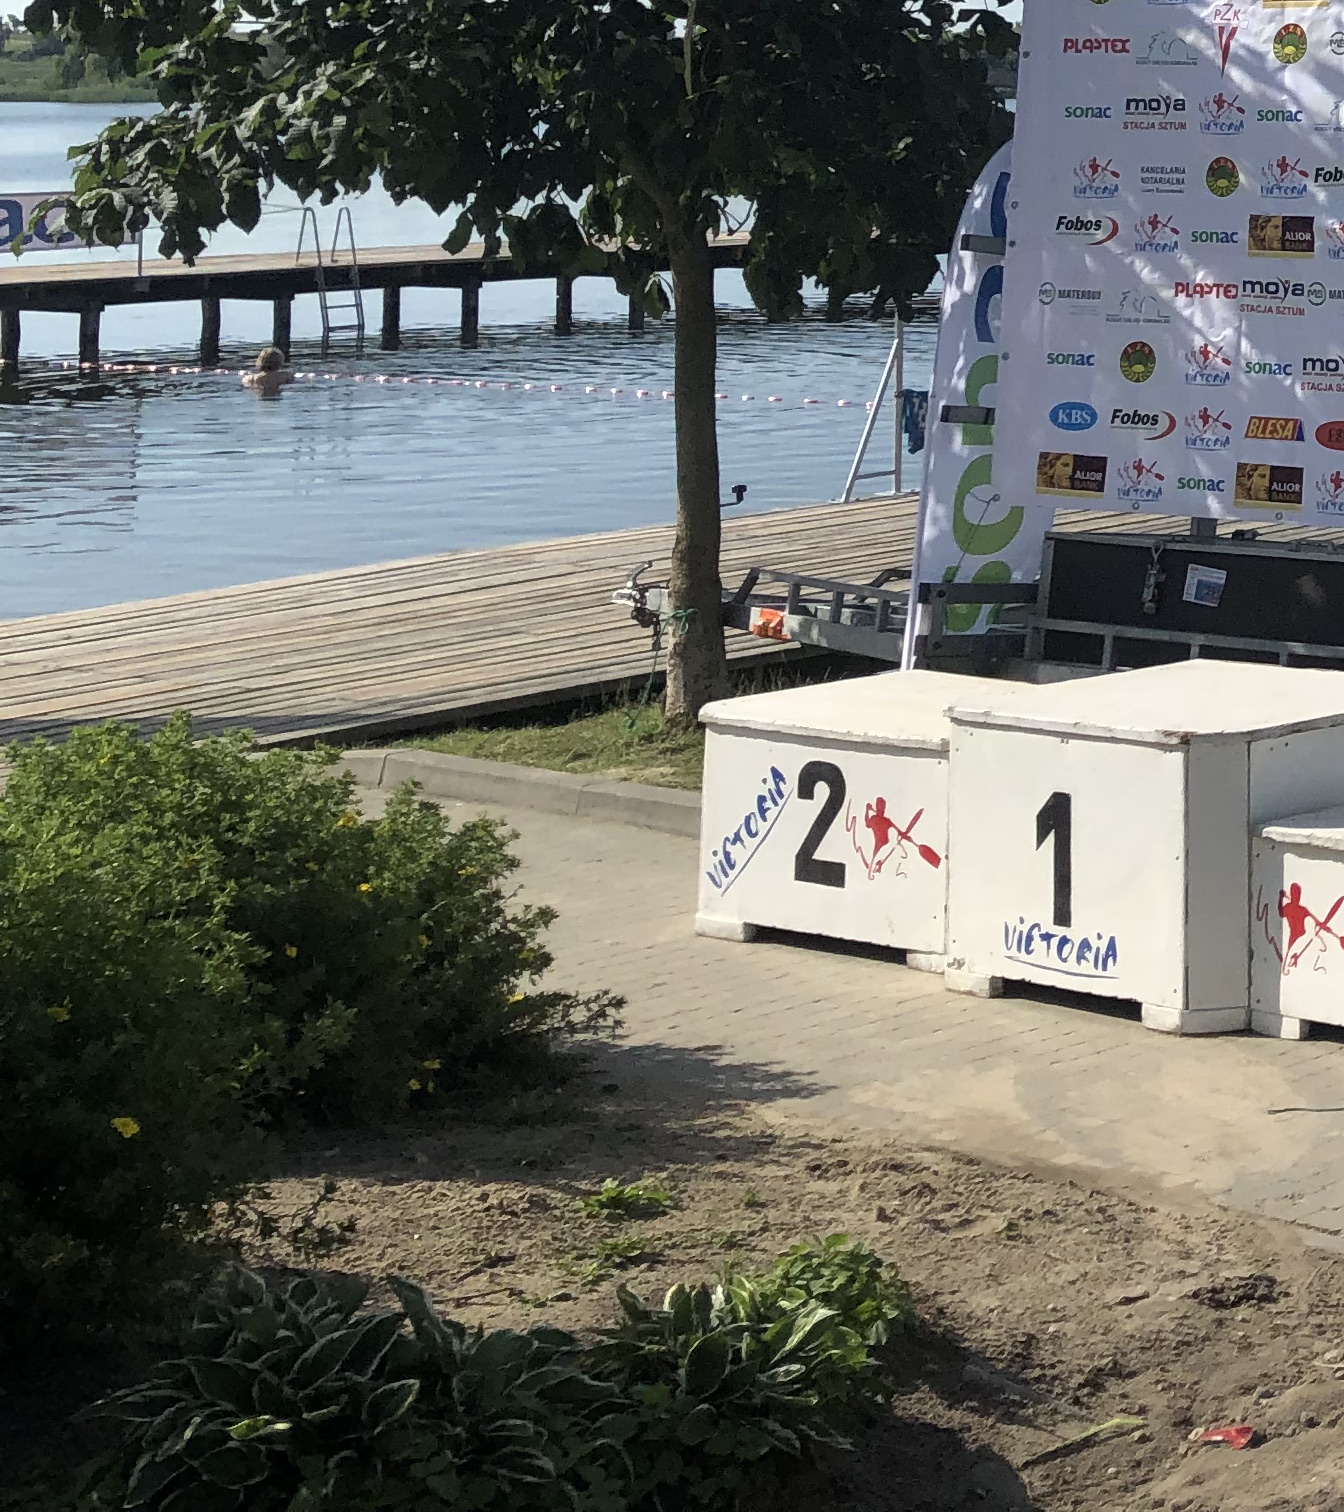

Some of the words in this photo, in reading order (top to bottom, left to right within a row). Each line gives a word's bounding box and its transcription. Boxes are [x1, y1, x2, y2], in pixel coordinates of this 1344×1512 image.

[1214, 3, 1241, 21] PZK
[1065, 106, 1111, 118] sonac
[1125, 95, 1185, 119] moya
[1257, 109, 1303, 122] sonac
[1123, 121, 1156, 130] STACJA
[1159, 122, 1186, 130] SZTUM
[1141, 166, 1186, 175] KANCELARIA
[1055, 216, 1101, 231] Fobos
[1191, 230, 1238, 243] sonac
[1242, 278, 1304, 303] moya
[1240, 304, 1273, 314] STACJA
[1276, 306, 1305, 315] SZTUM
[1047, 352, 1095, 366] sonac
[1245, 361, 1292, 375] sonac
[1301, 382, 1334, 391] STACJA
[1058, 409, 1091, 423] KBS
[1111, 409, 1159, 426] Fobos
[1248, 419, 1294, 438] BLESA
[1074, 471, 1102, 480] ALIOR
[1177, 476, 1225, 492] sonac
[1271, 482, 1300, 492] ALIOR
[794, 760, 846, 888] 2
[1035, 791, 1071, 927] 1
